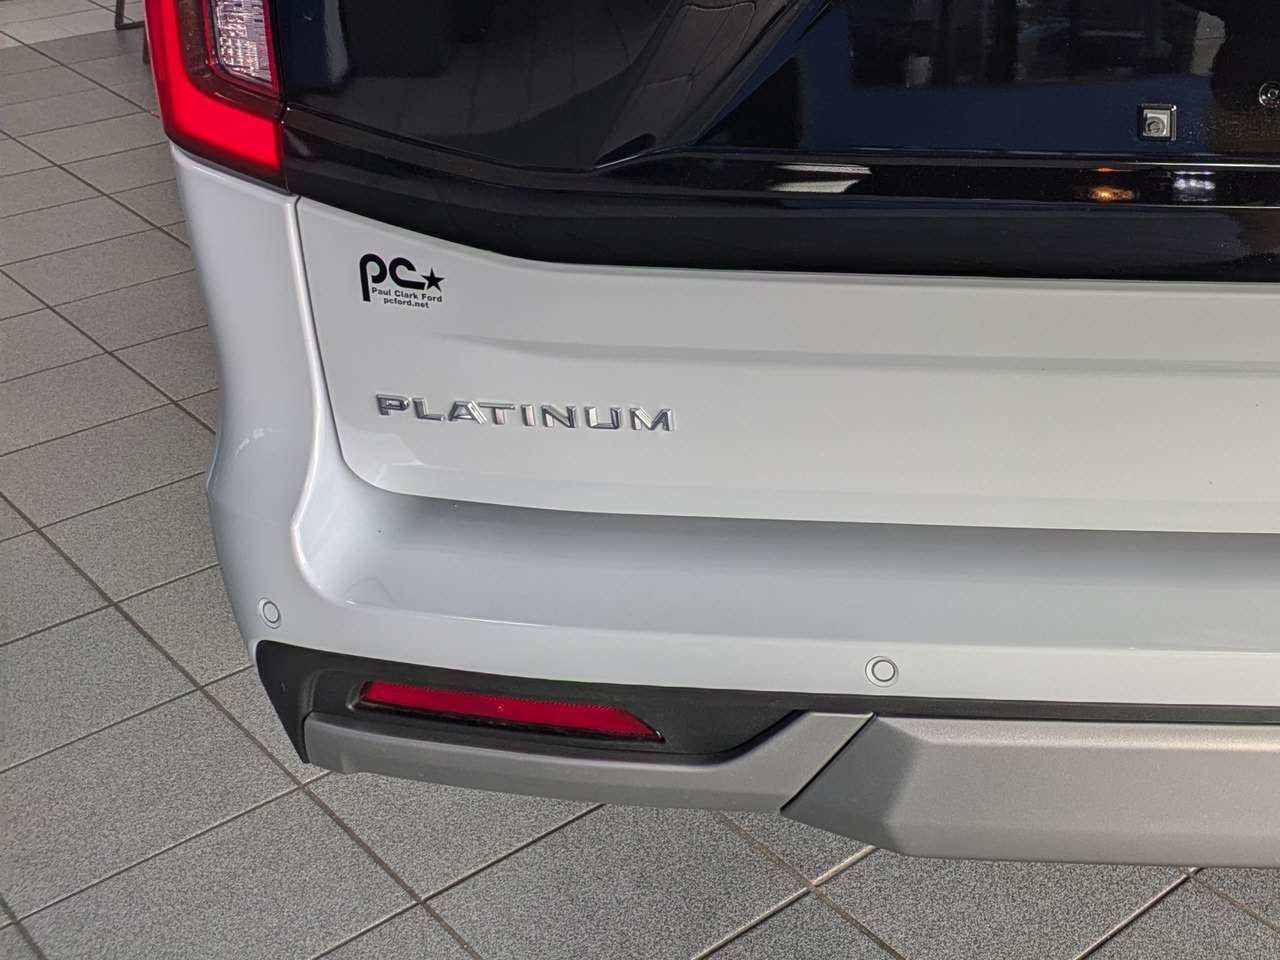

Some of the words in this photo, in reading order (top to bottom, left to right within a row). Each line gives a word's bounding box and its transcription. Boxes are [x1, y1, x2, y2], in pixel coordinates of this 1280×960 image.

[371, 287, 392, 296] Paul
[394, 289, 419, 300] Clark
[421, 293, 443, 303] Ford
[383, 297, 430, 309] pcford.net
[376, 393, 675, 432] PLATINUM
